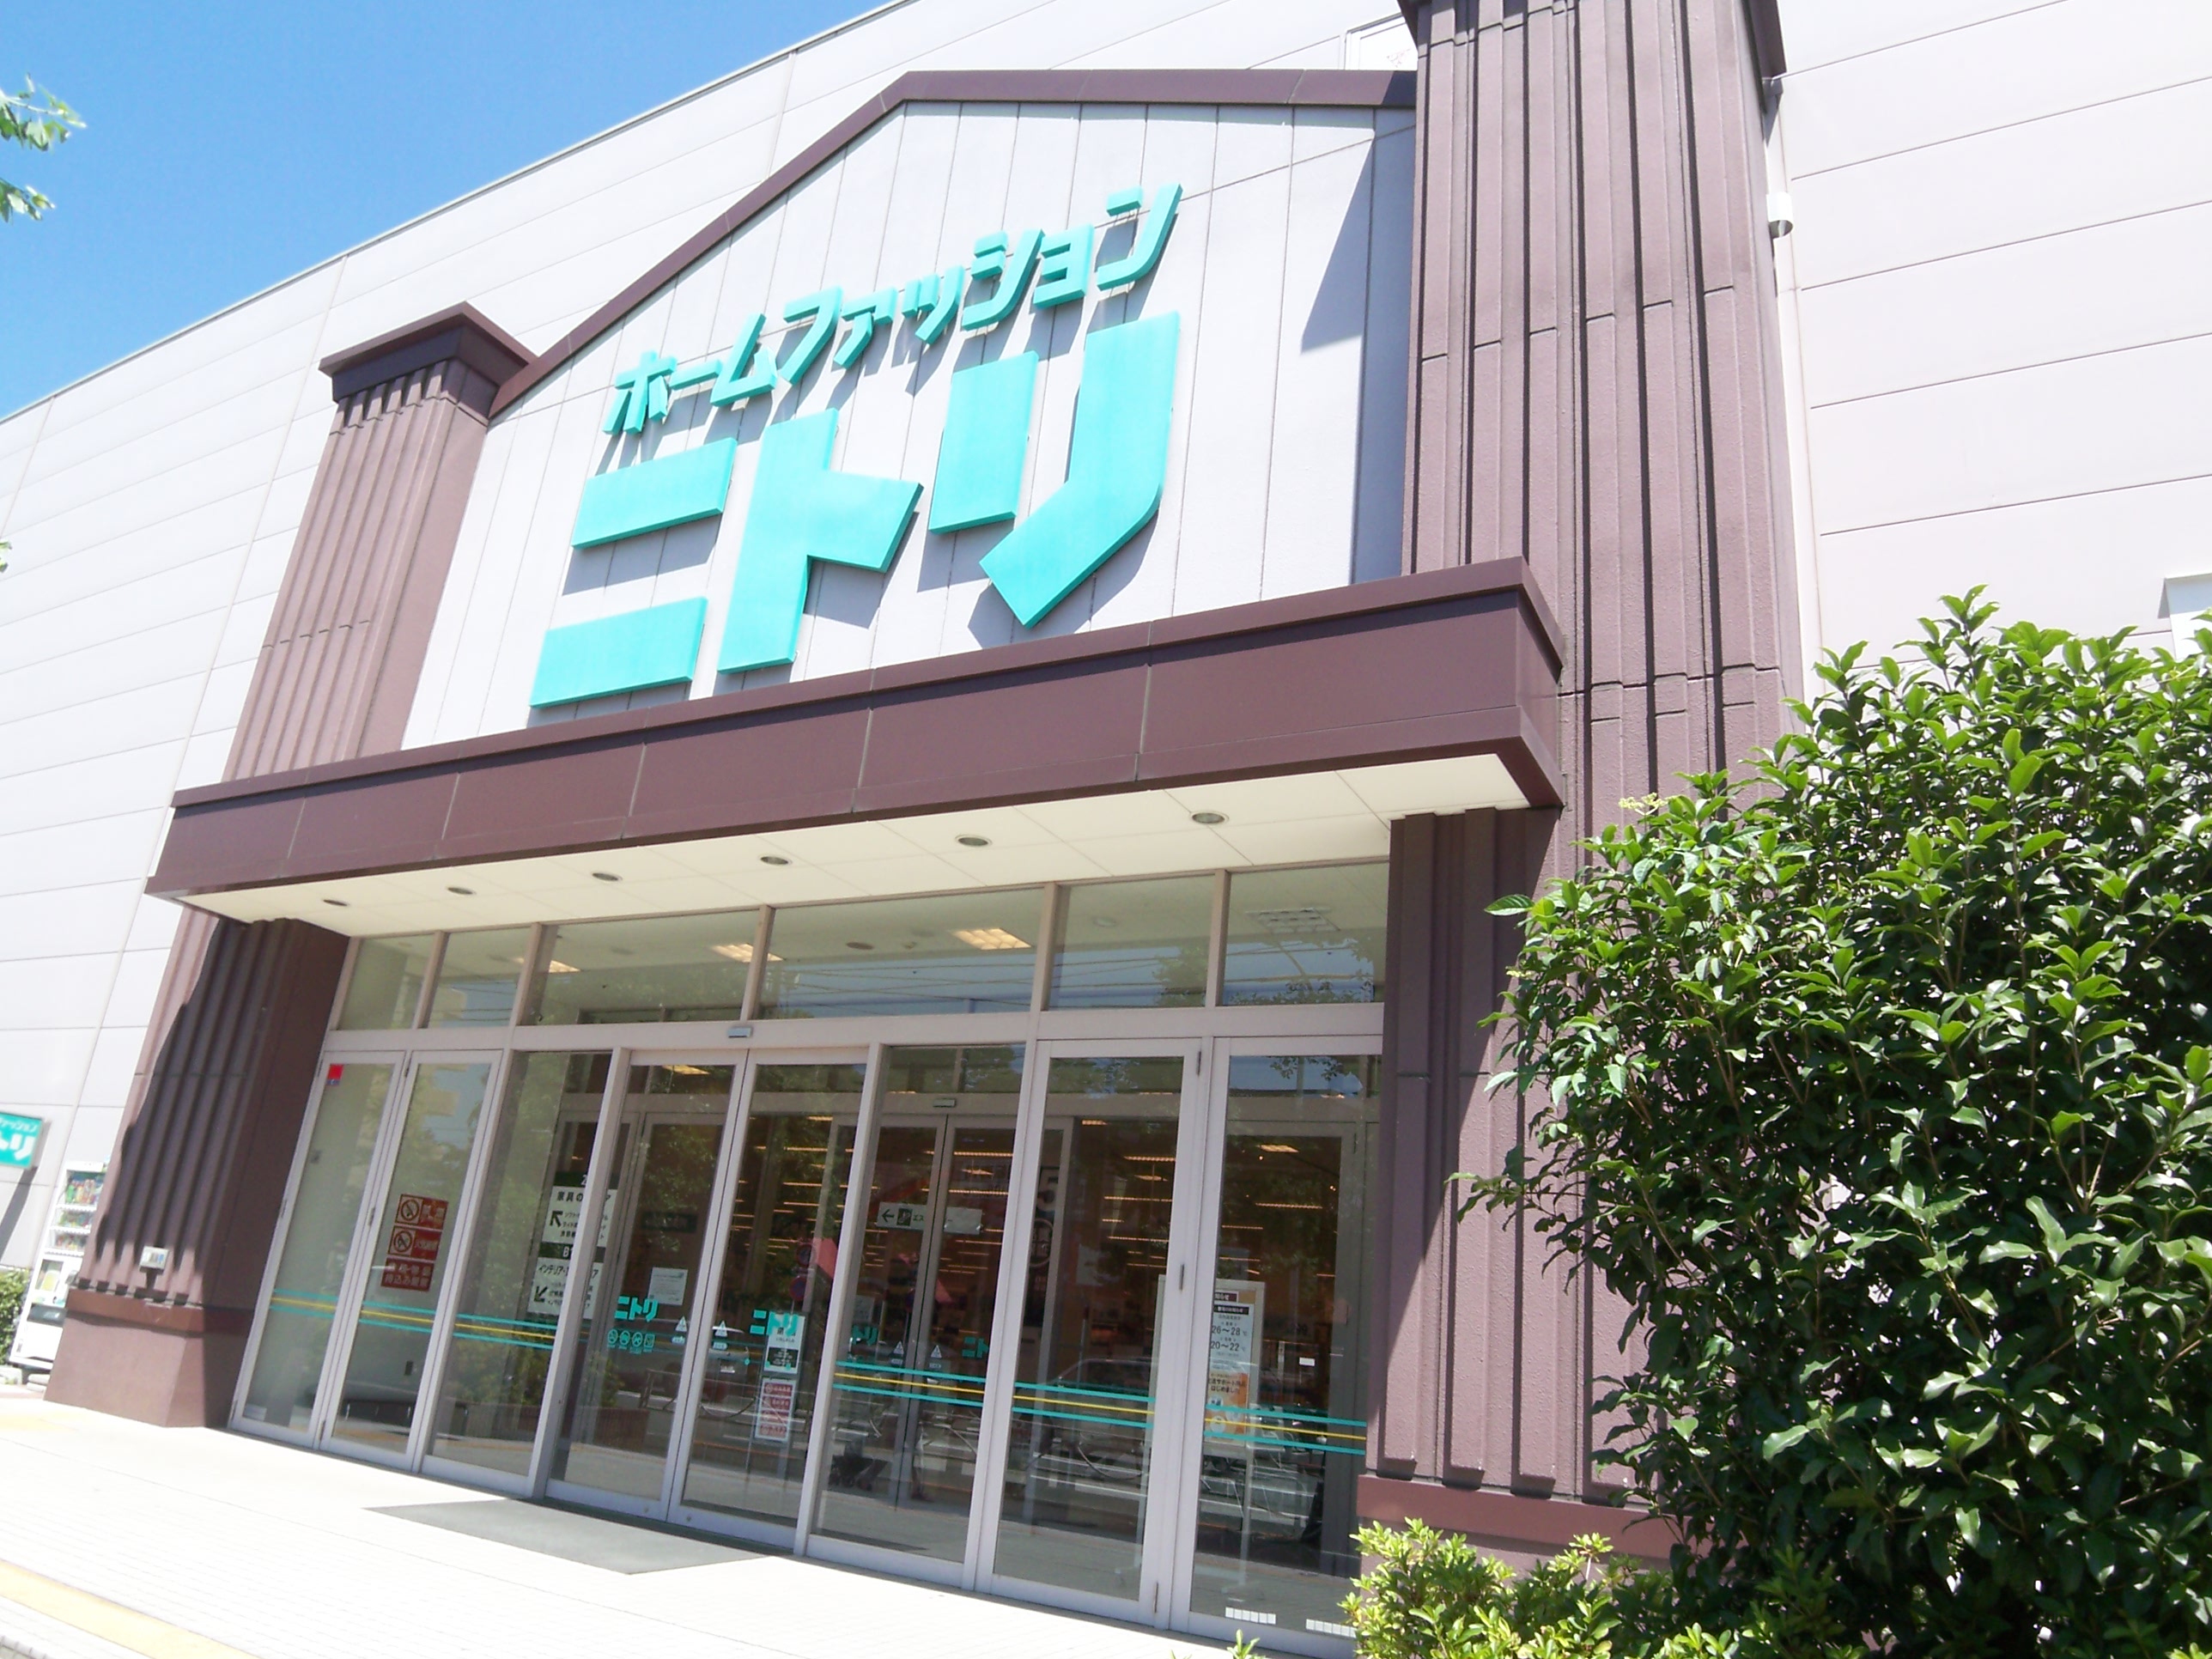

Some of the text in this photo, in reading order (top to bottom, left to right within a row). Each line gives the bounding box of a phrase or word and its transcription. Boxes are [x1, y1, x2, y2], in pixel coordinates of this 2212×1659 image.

[604, 183, 1183, 434] ホームファッション
[530, 311, 1181, 708] ニトリ
[614, 1295, 659, 1322] ニトリ
[750, 1309, 799, 1337] ニトリ
